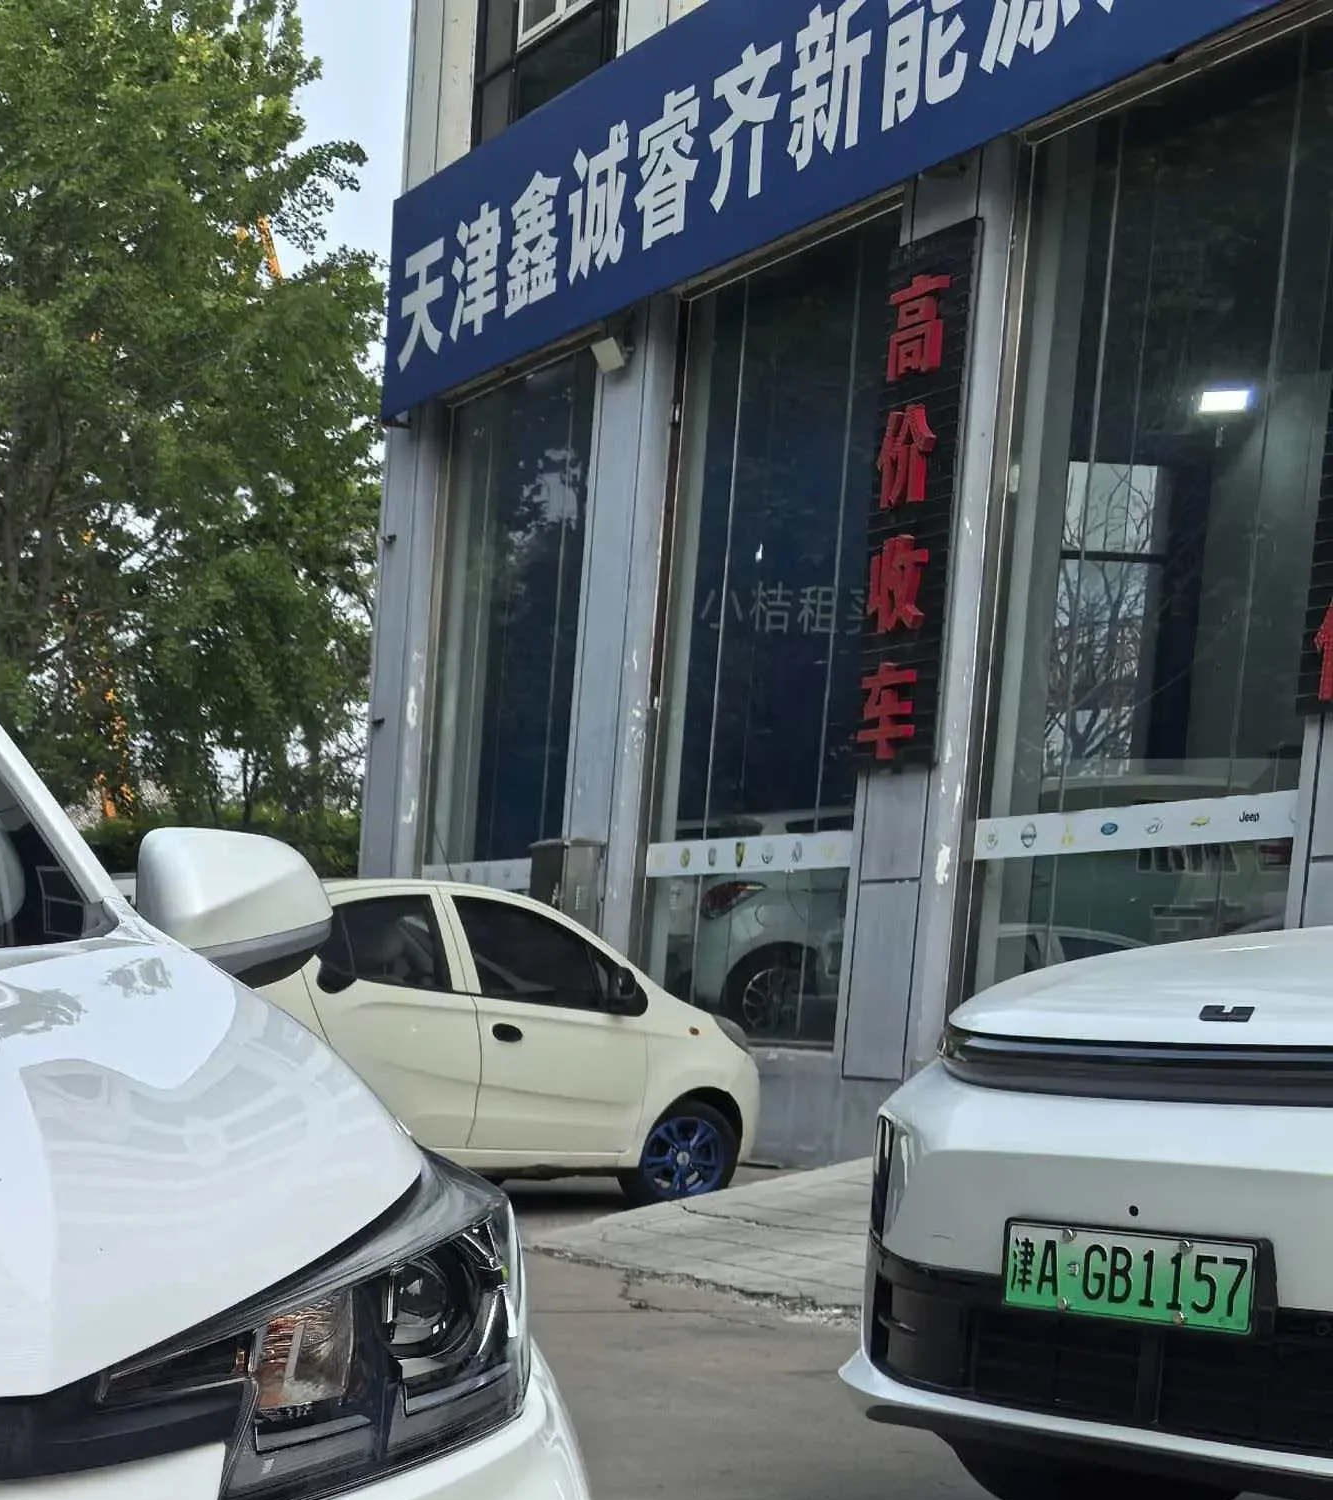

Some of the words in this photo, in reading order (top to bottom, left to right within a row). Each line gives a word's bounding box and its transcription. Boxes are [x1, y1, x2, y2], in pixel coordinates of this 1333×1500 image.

[398, 0, 1115, 372] 天津鑫诚睿齐新能
[858, 274, 951, 760] 高价收车
[1239, 810, 1260, 824] Jeep
